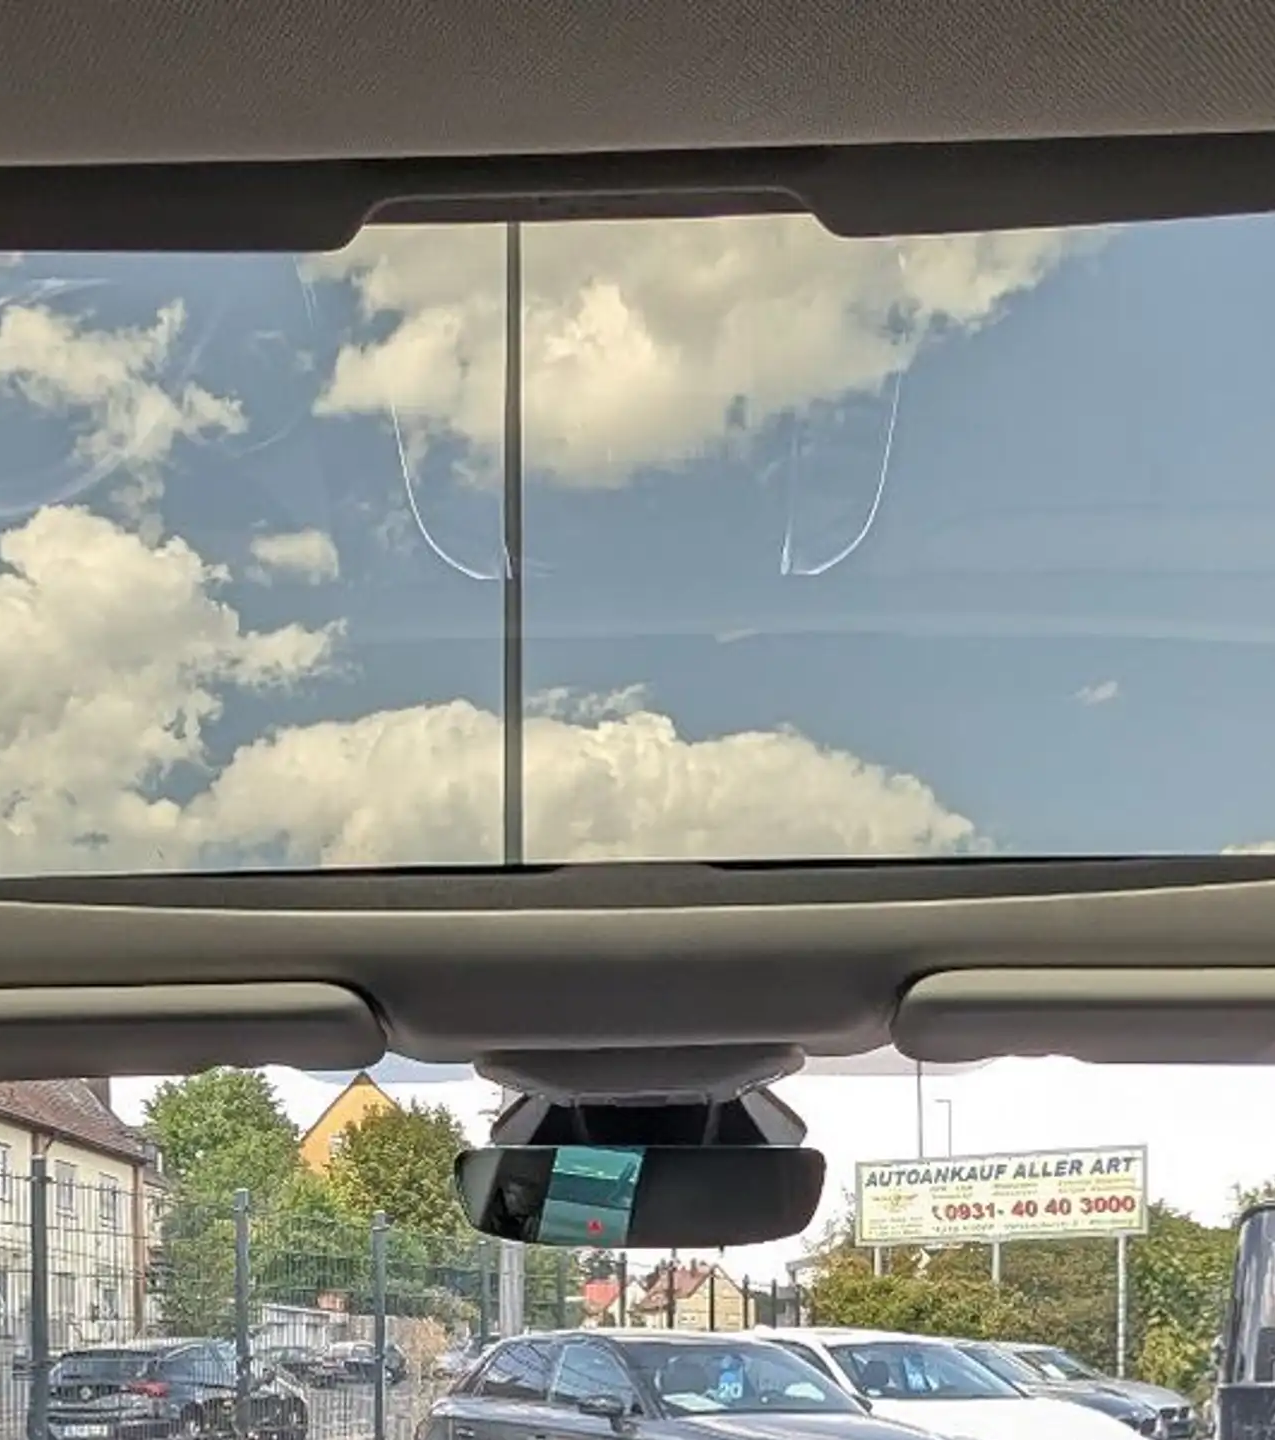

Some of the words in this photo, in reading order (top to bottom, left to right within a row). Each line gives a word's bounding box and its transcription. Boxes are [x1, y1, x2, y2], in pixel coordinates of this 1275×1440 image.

[865, 1162, 1007, 1188] AUTOANKAUF
[1013, 1158, 1083, 1181] ALLER
[1089, 1155, 1134, 1176] ART
[1010, 1199, 1038, 1218] 40
[1044, 1197, 1072, 1217] 40
[1079, 1194, 1137, 1216] 3000
[718, 1382, 744, 1399] 20
